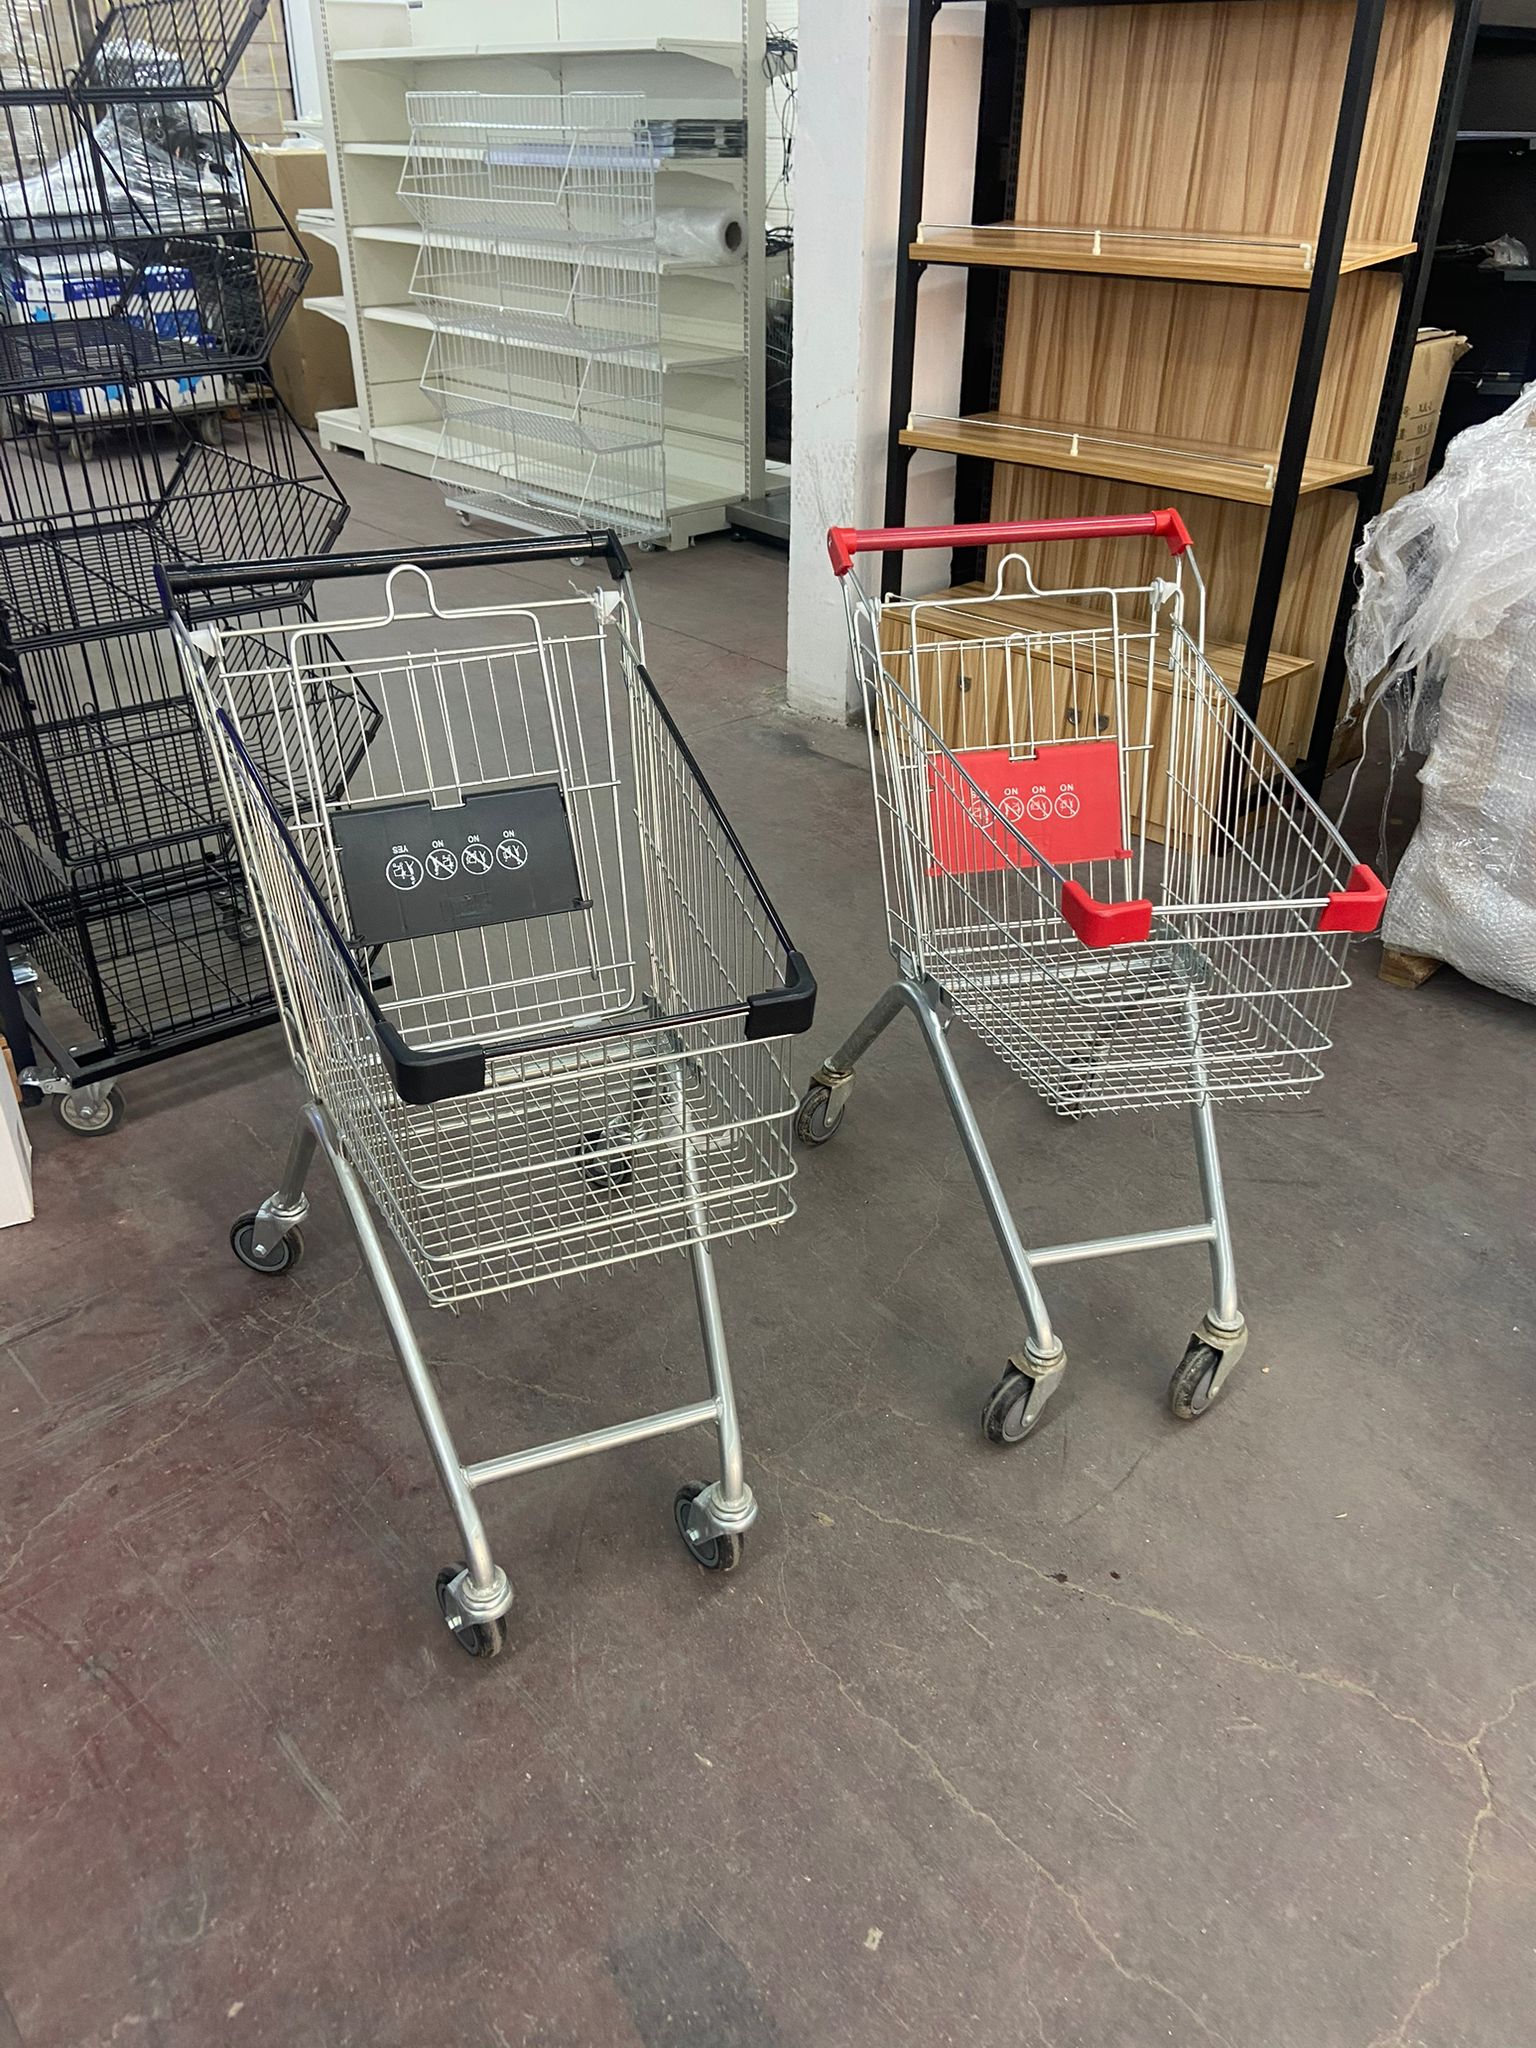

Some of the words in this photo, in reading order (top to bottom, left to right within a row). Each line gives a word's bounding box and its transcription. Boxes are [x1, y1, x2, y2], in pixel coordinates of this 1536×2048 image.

[1032, 786, 1046, 794] NO
[1060, 784, 1074, 792] NO
[503, 830, 515, 838] NO
[468, 834, 480, 843] NO
[432, 840, 444, 848] NO
[392, 845, 409, 854] YES
